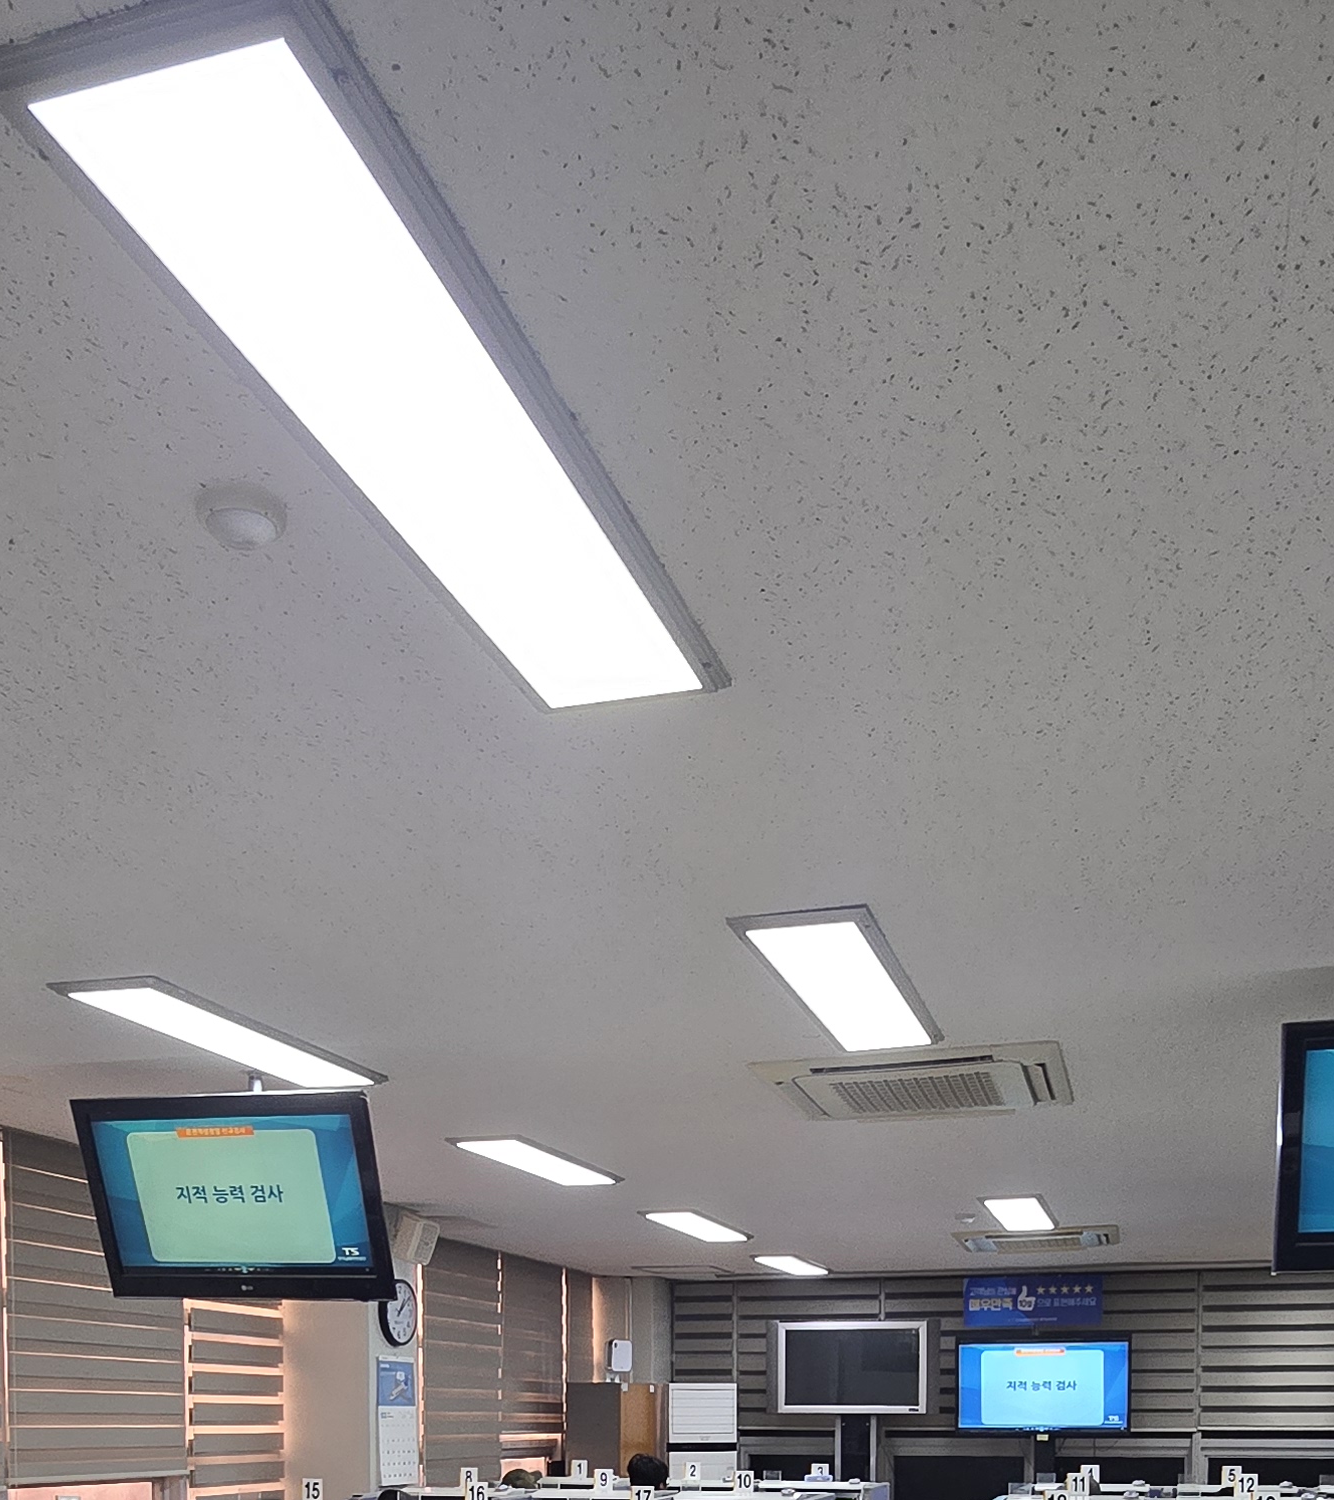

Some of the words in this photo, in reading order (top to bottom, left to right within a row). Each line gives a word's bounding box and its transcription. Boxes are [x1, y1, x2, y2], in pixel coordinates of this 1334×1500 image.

[175, 1185, 209, 1204] 지적
[212, 1184, 245, 1204] 능력
[250, 1183, 284, 1203] 검사
[342, 1247, 359, 1256] TS
[1006, 1381, 1028, 1391] 지적
[1031, 1381, 1052, 1391] 능력
[1056, 1380, 1077, 1391] 검사
[578, 1463, 581, 1474] 1
[690, 1465, 695, 1476] 2
[1228, 1469, 1235, 1482] 5
[601, 1472, 607, 1486] 9
[737, 1474, 751, 1488] 10
[1073, 1477, 1084, 1492] 11
[1239, 1477, 1254, 1495] 12
[305, 1482, 319, 1499] 15
